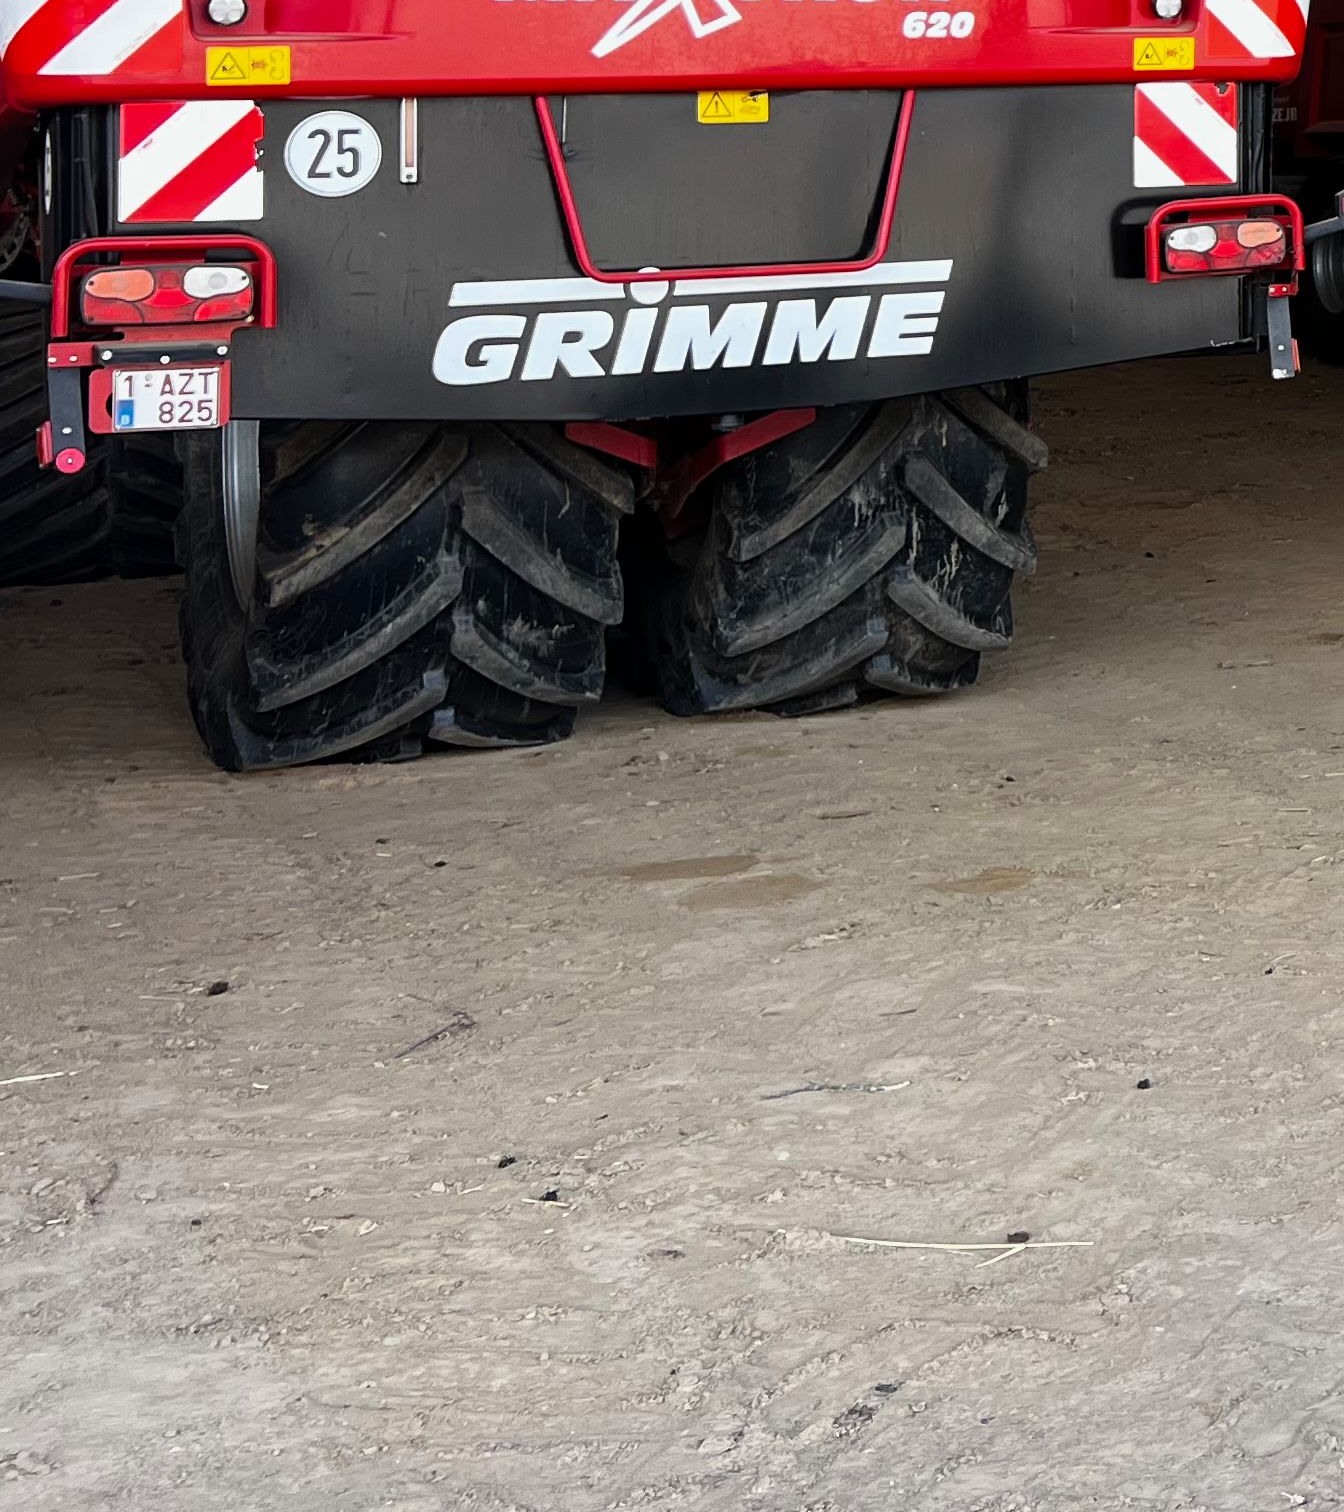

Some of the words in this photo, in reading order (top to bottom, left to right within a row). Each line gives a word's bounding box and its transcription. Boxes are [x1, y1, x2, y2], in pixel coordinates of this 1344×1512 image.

[903, 11, 975, 39] 620
[307, 129, 361, 179] 25
[432, 268, 945, 385] GRIMME
[158, 400, 214, 424] 825
